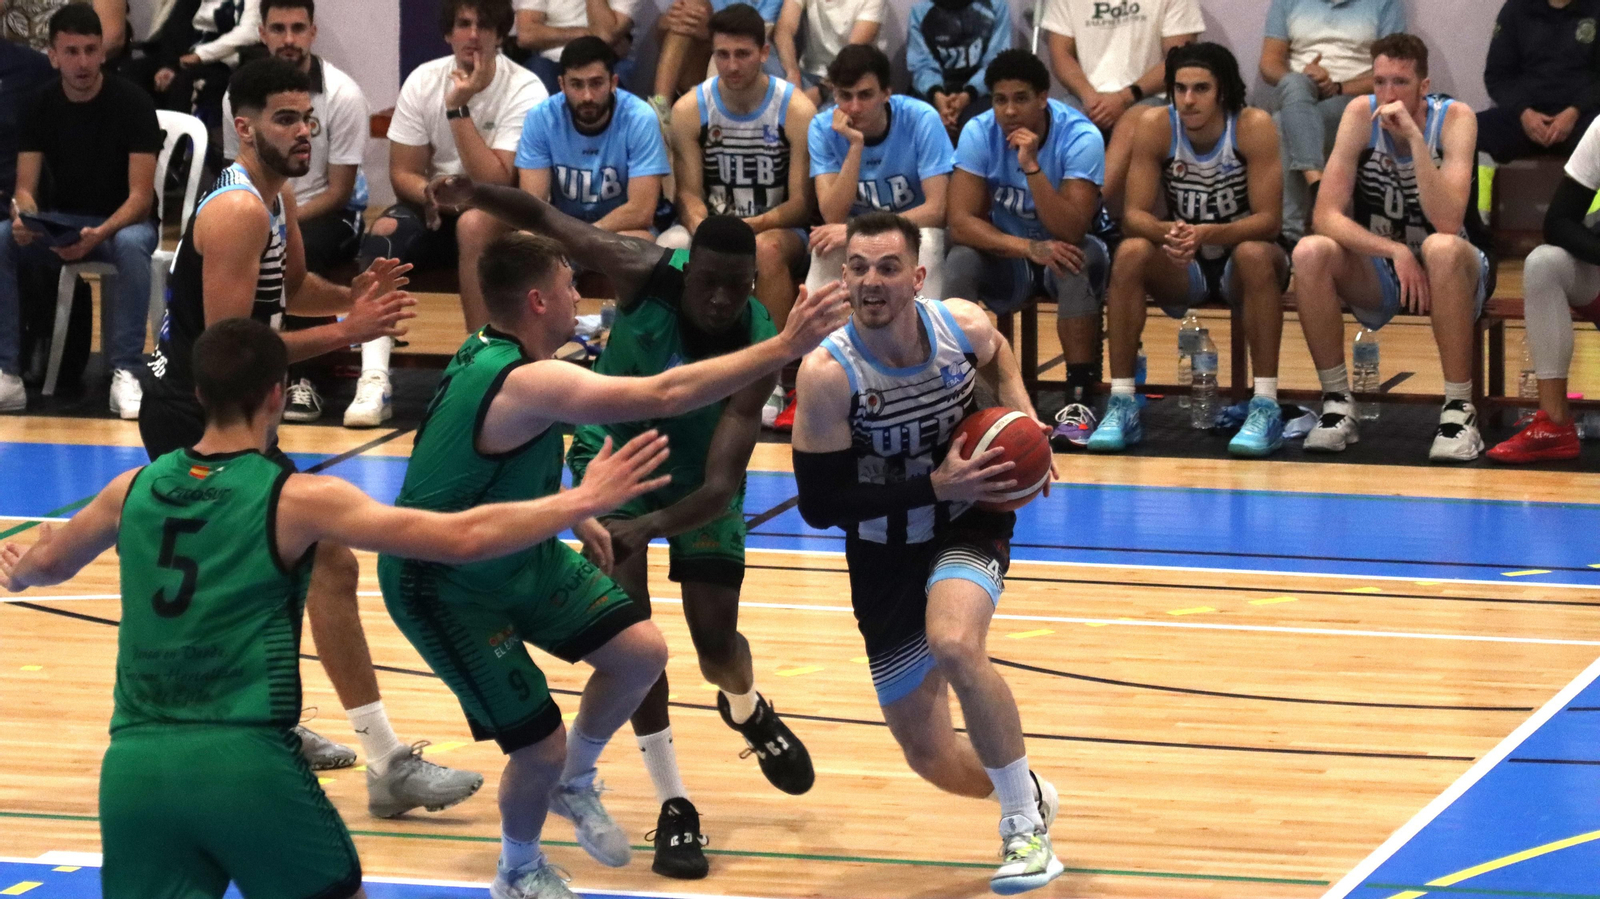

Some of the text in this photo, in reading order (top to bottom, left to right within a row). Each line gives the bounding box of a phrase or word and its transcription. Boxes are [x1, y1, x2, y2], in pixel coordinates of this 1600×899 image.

[1092, 0, 1140, 19] Polo
[556, 165, 623, 204] ULB
[716, 153, 775, 186] ULB
[1176, 186, 1239, 221] ULB
[151, 516, 209, 619] 5
[508, 668, 530, 702] 9
